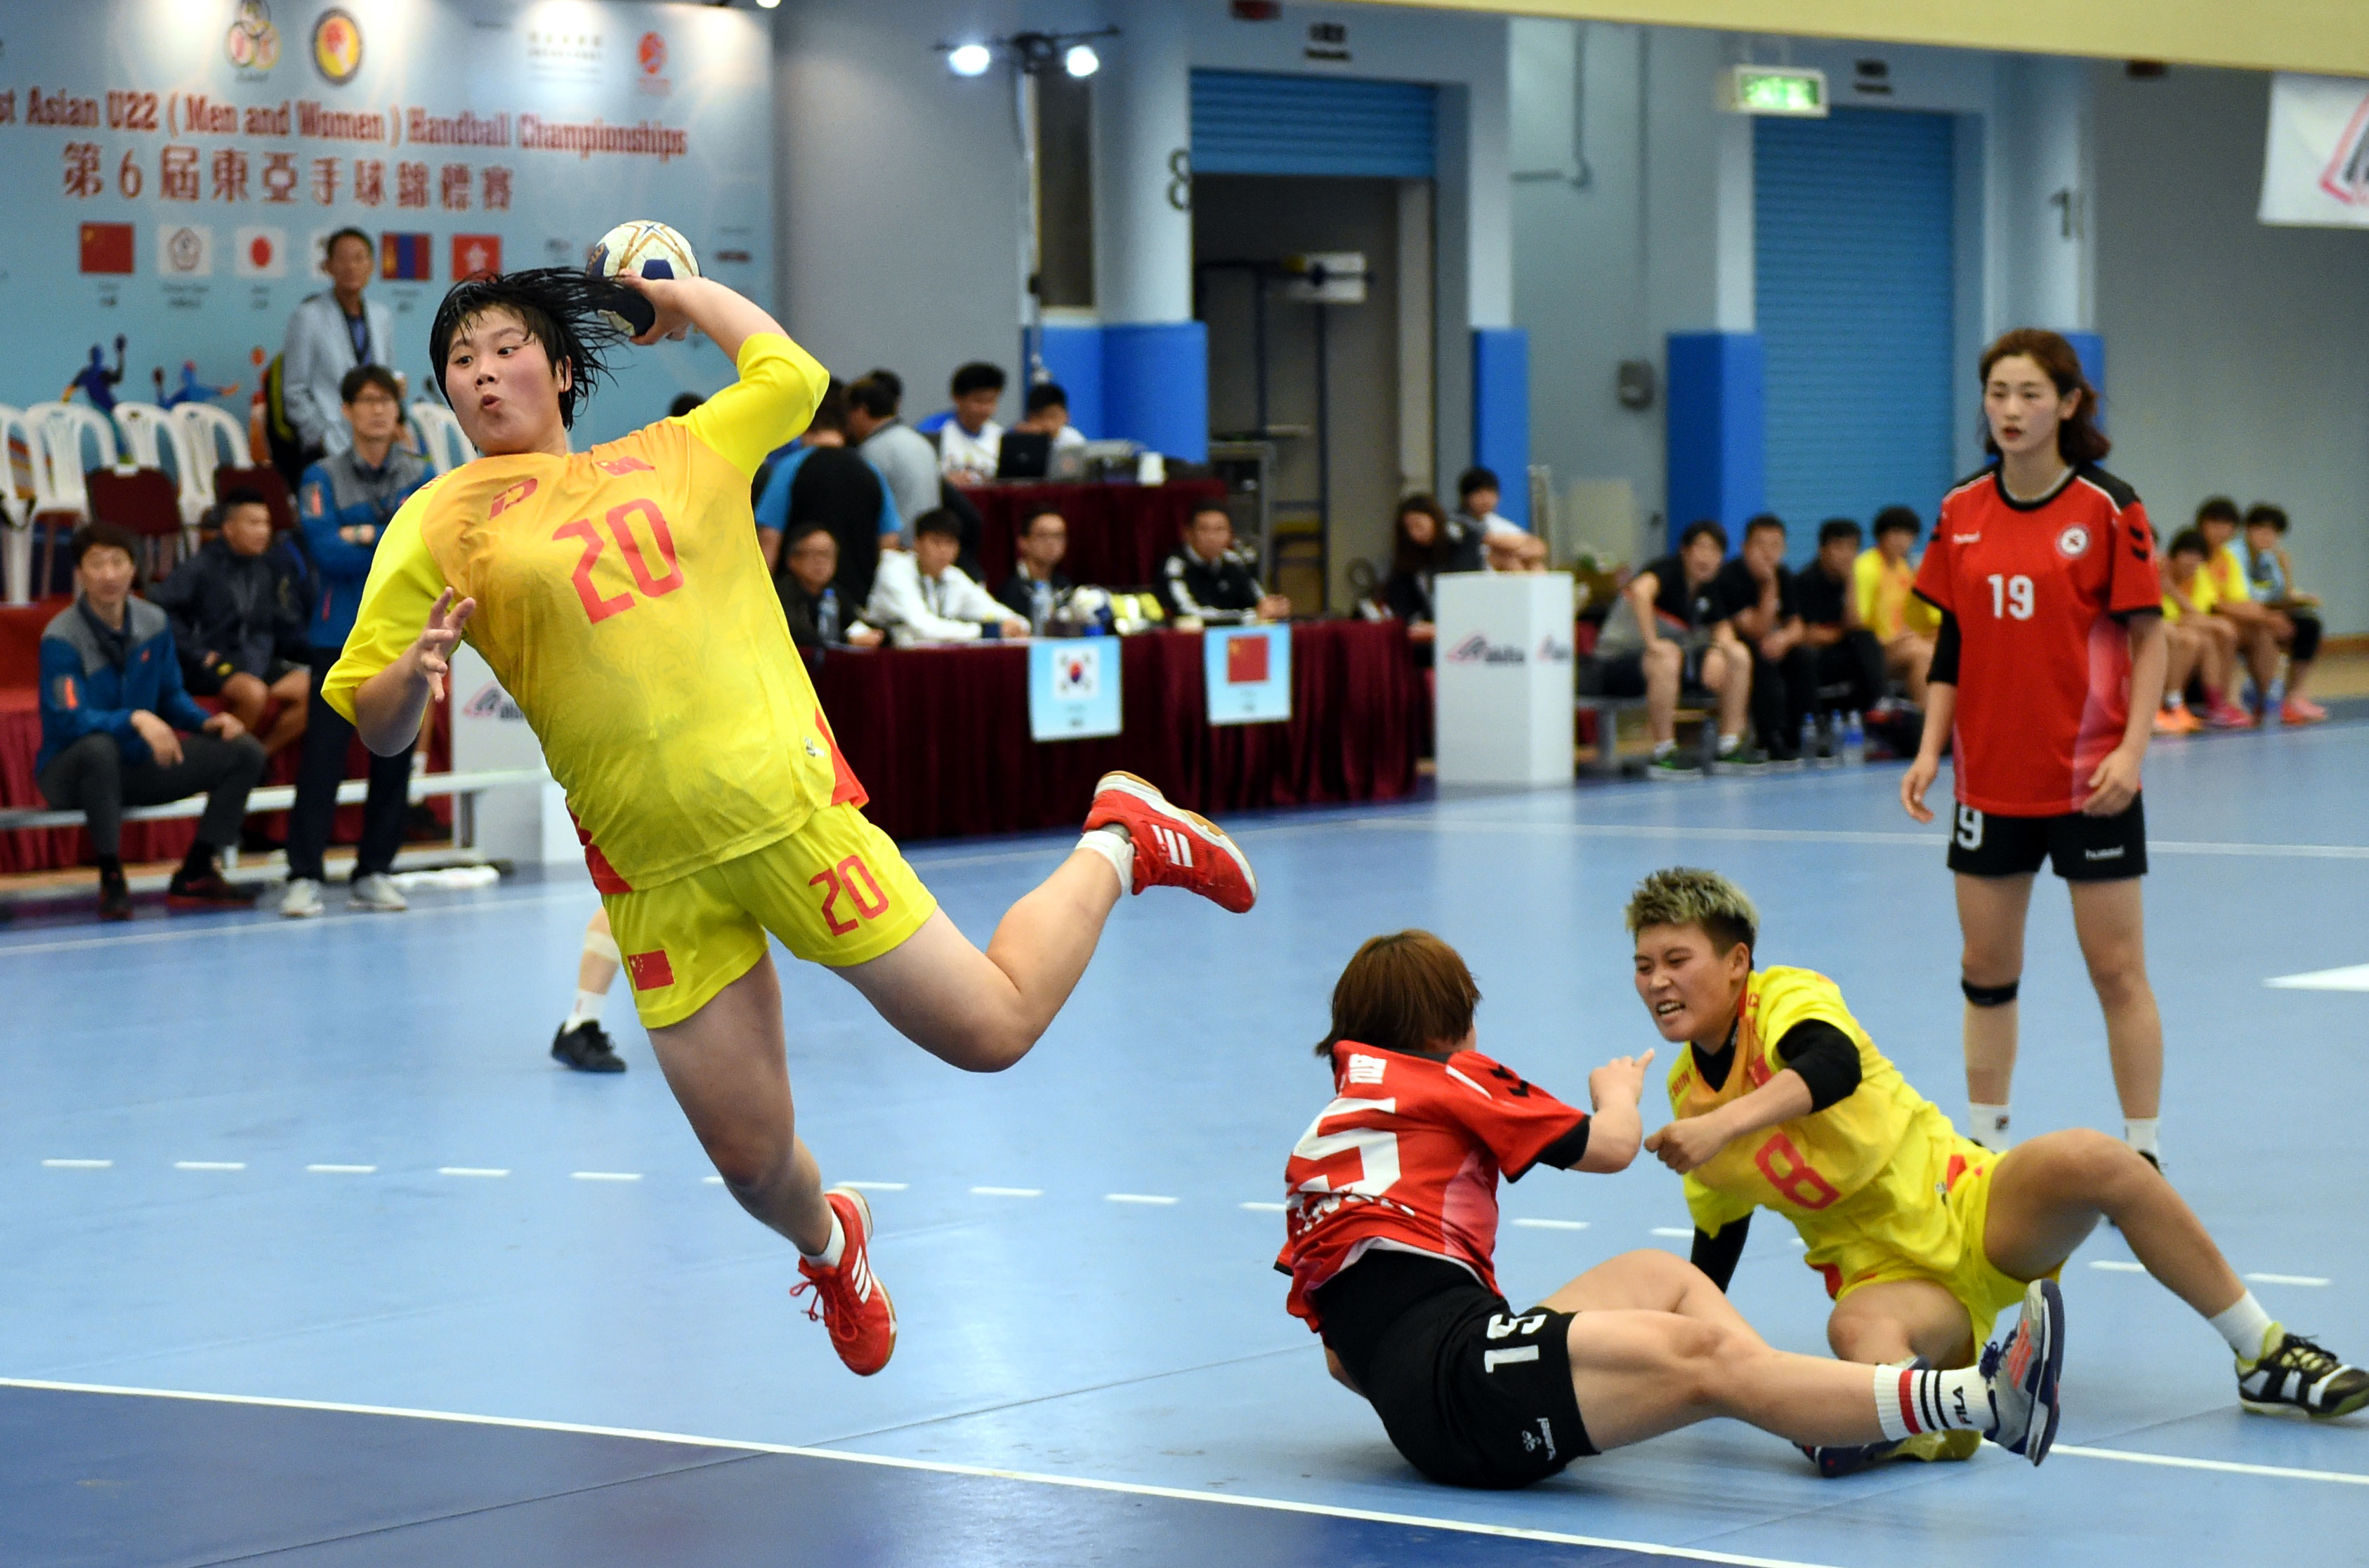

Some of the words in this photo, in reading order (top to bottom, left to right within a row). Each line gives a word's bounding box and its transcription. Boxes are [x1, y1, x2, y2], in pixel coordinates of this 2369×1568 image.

[0, 88, 17, 126] st
[27, 85, 100, 127] Asian
[107, 89, 159, 132] U22
[244, 100, 291, 137] and
[407, 105, 511, 147] Handball
[518, 112, 688, 162] Championships
[552, 497, 684, 625] 20
[1987, 573, 2035, 621] 19
[1954, 803, 1984, 852] 9
[808, 854, 890, 937] 20
[1291, 1096, 1402, 1199] 5
[1754, 1132, 1842, 1211] 8
[1484, 1313, 1547, 1373] 15
[1953, 1385, 1973, 1425] FILA
